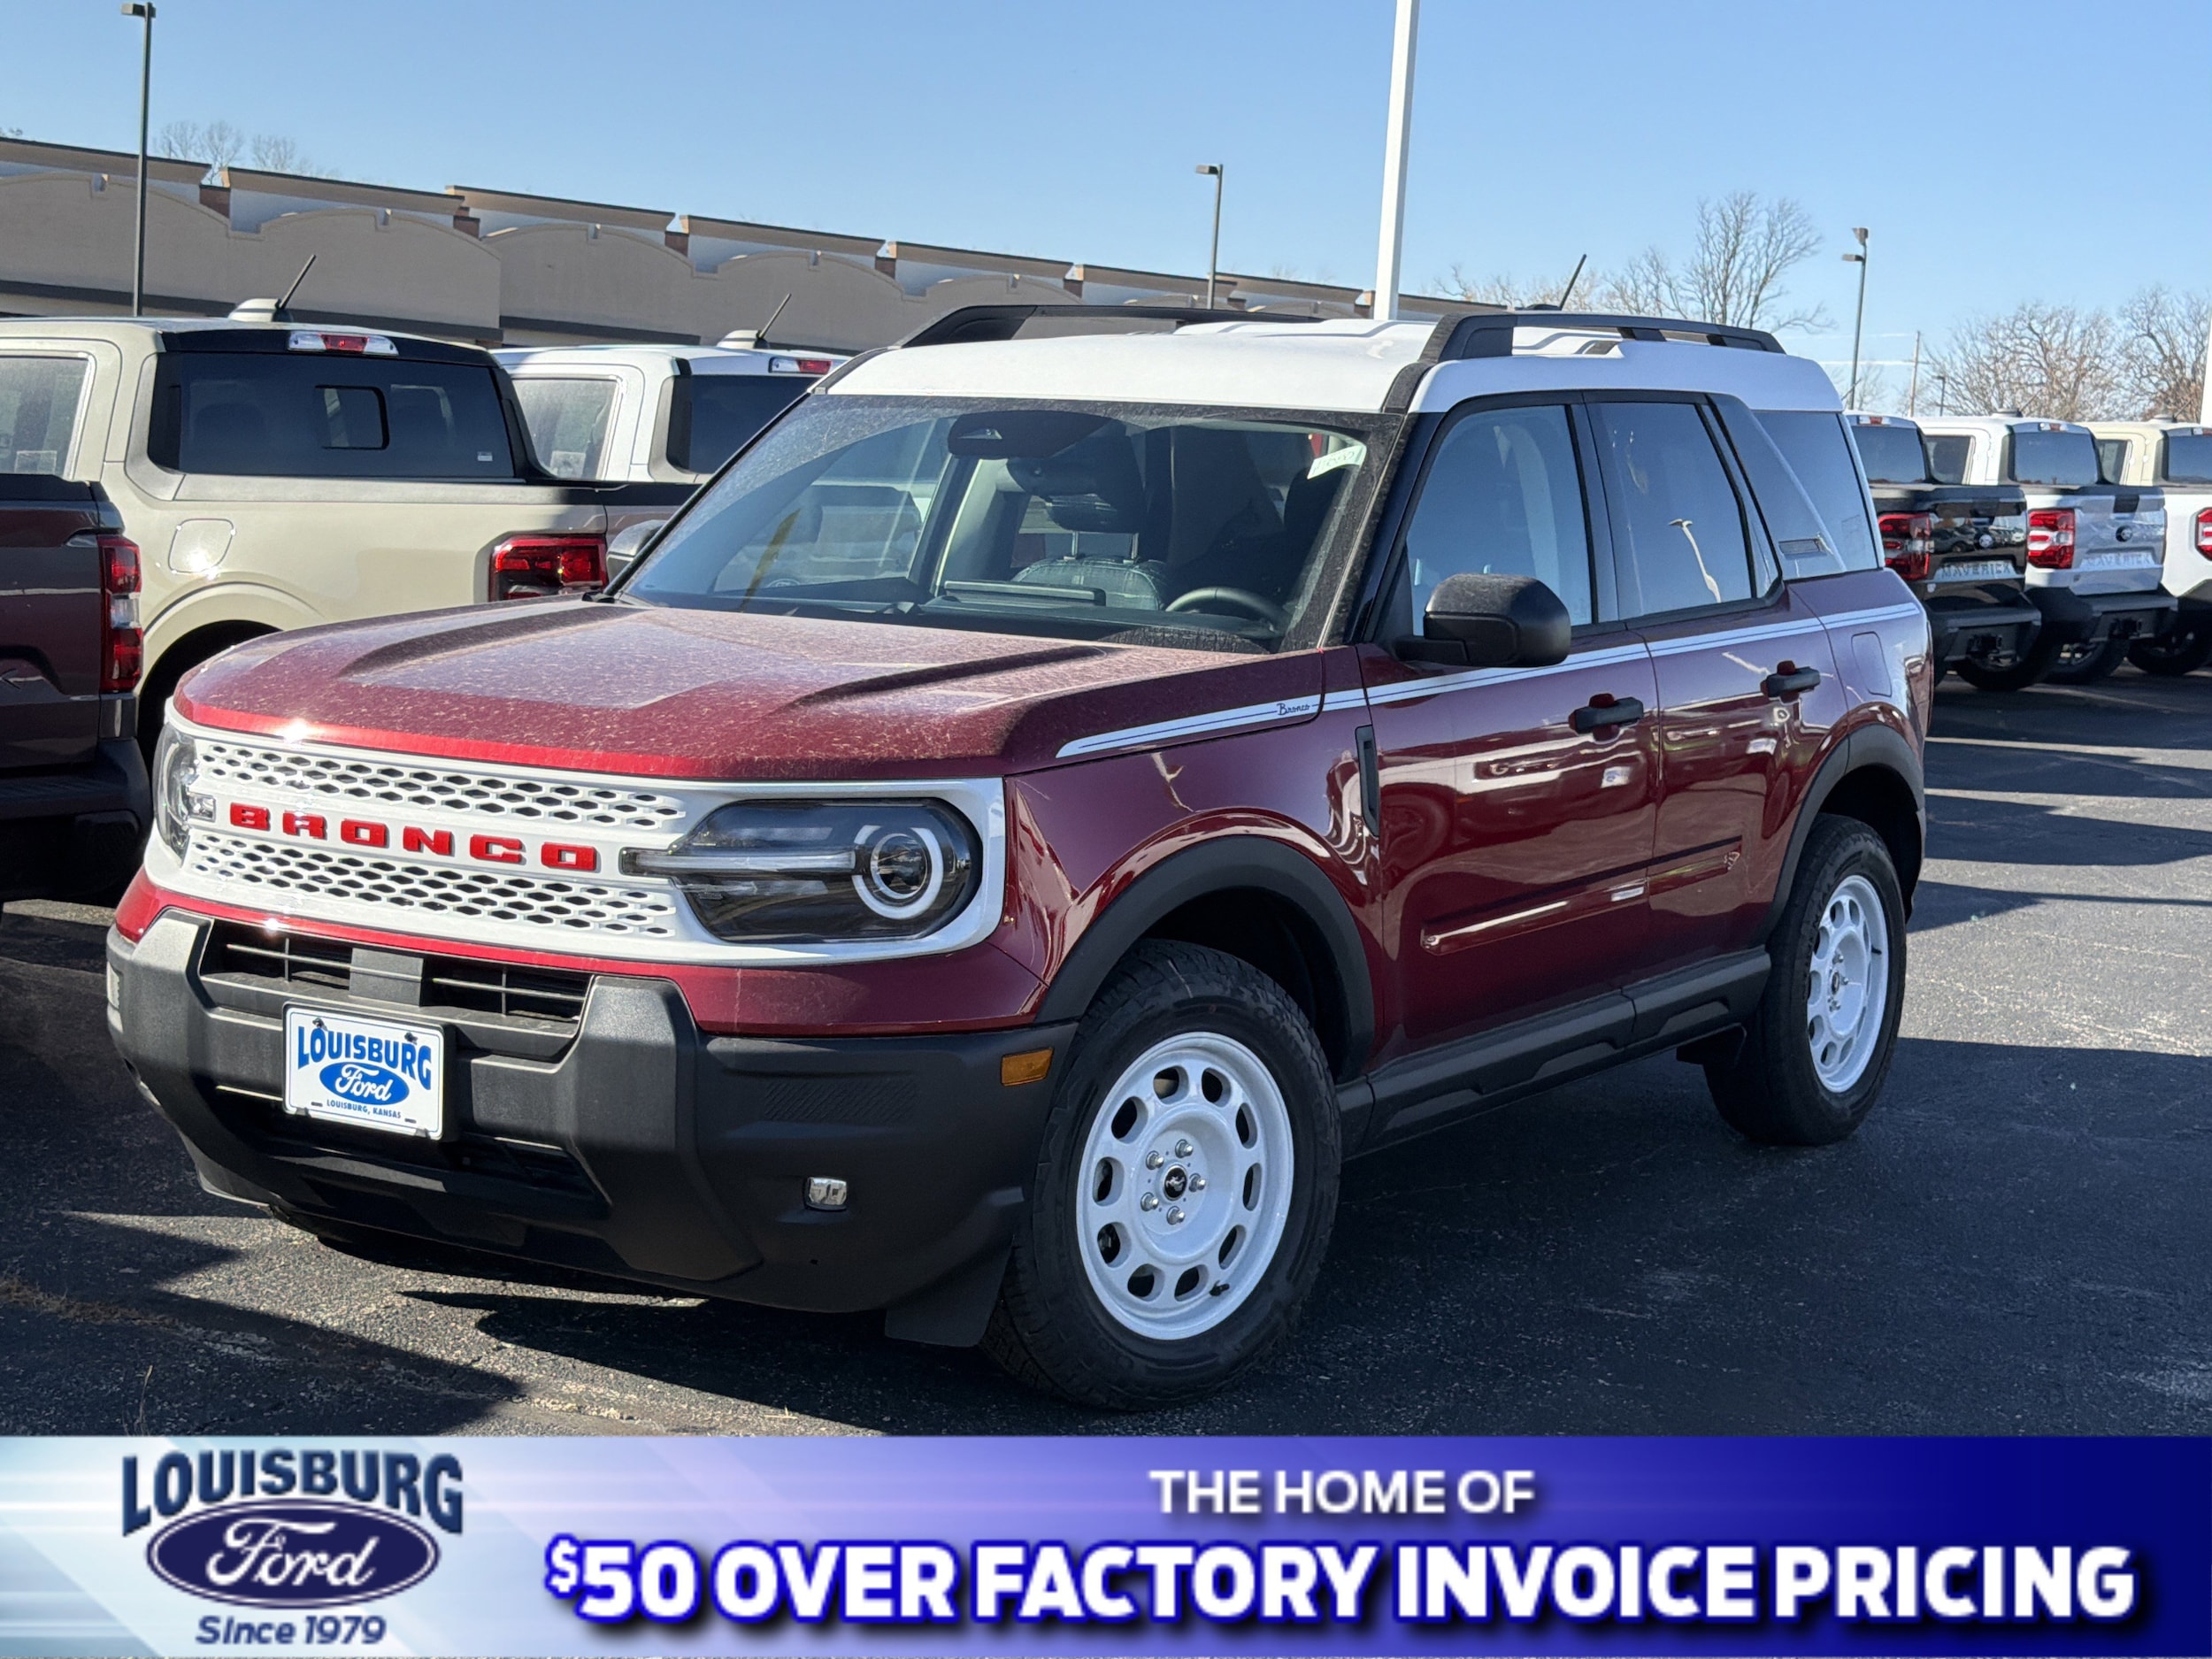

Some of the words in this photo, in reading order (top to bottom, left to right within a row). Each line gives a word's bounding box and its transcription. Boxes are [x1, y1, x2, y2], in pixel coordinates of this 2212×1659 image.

[1941, 562, 2011, 578] MAVERICK
[1276, 703, 1310, 716] Bronco
[230, 802, 598, 872] BRONCO
[297, 1025, 432, 1091] LOUISBURG
[334, 1064, 394, 1102] Ford
[326, 1099, 371, 1115] LOUISBURG,
[373, 1108, 402, 1119] KANSAS
